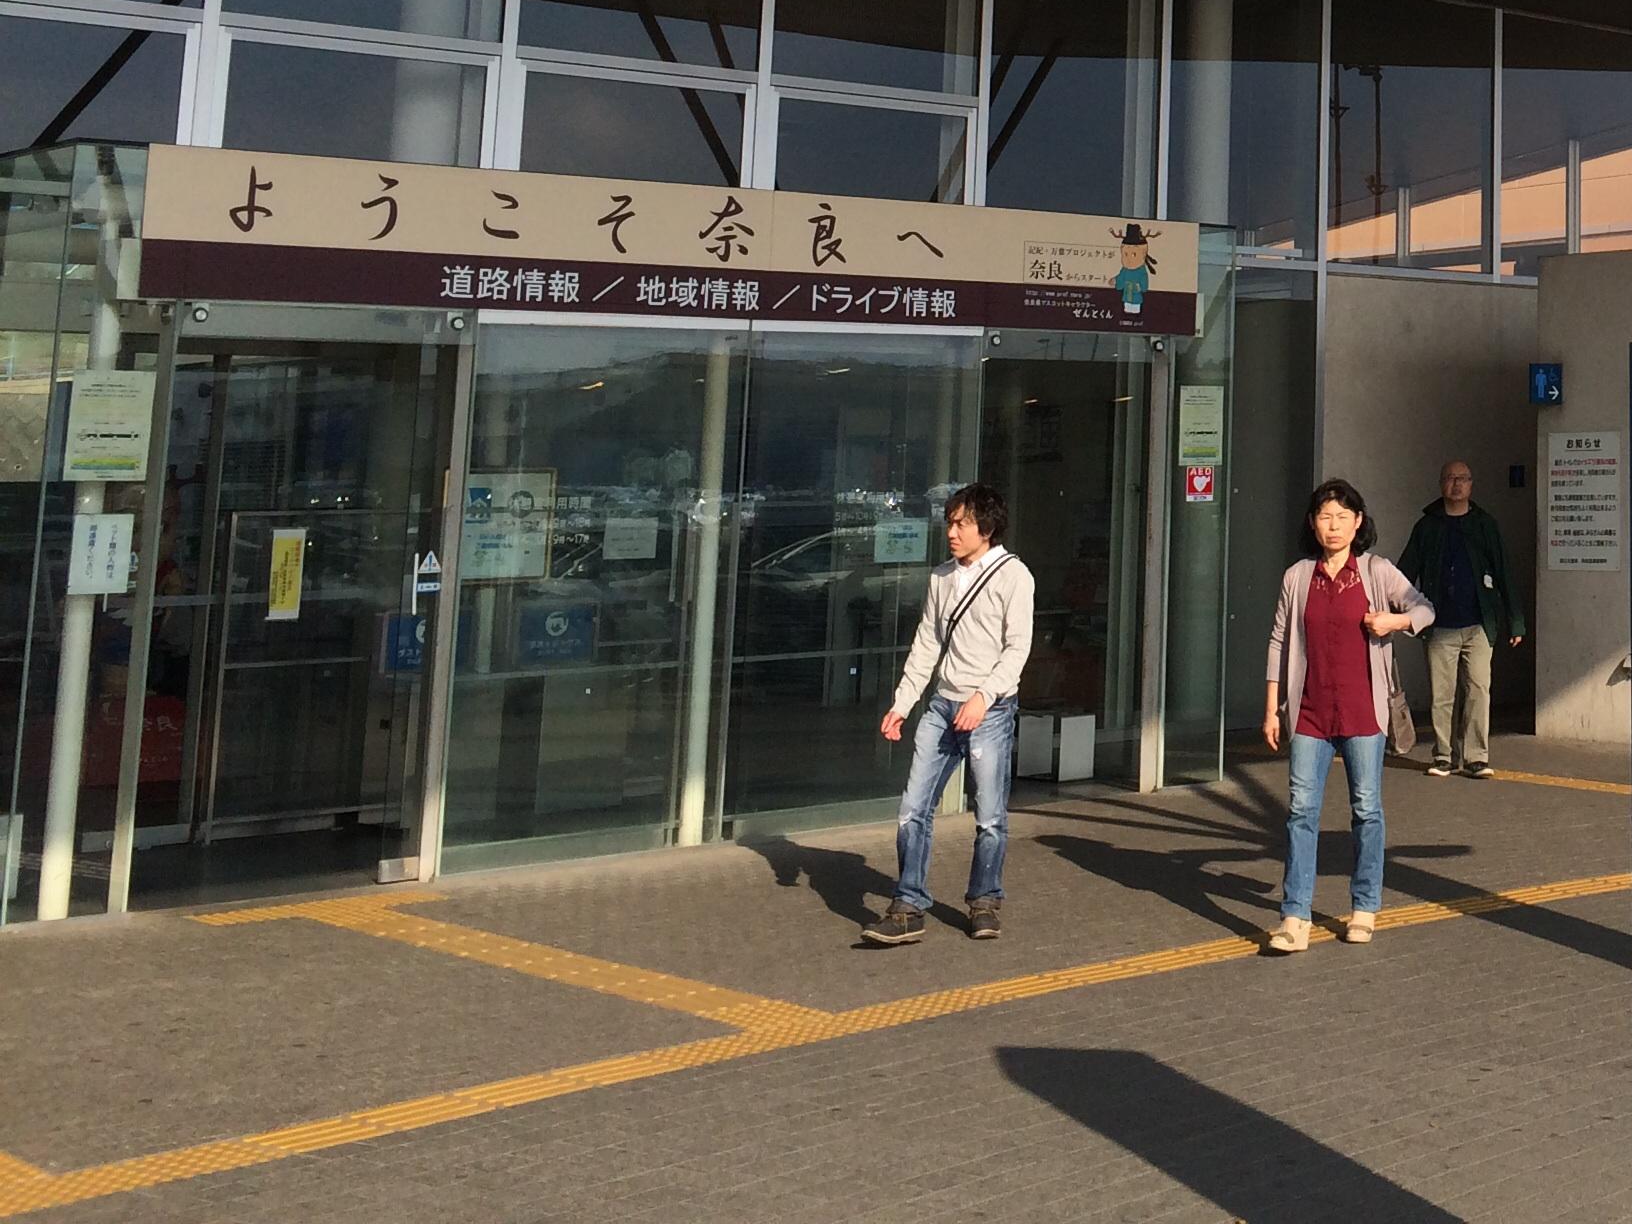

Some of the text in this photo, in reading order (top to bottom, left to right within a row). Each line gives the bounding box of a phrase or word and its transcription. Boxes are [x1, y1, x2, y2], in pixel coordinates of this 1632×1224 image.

[228, 165, 945, 268] ようこそ奈良へ
[1030, 259, 1063, 281] 奈良
[1073, 308, 1114, 320] せんとくん
[1566, 438, 1601, 449] お知らせ
[1190, 467, 1212, 476] AED
